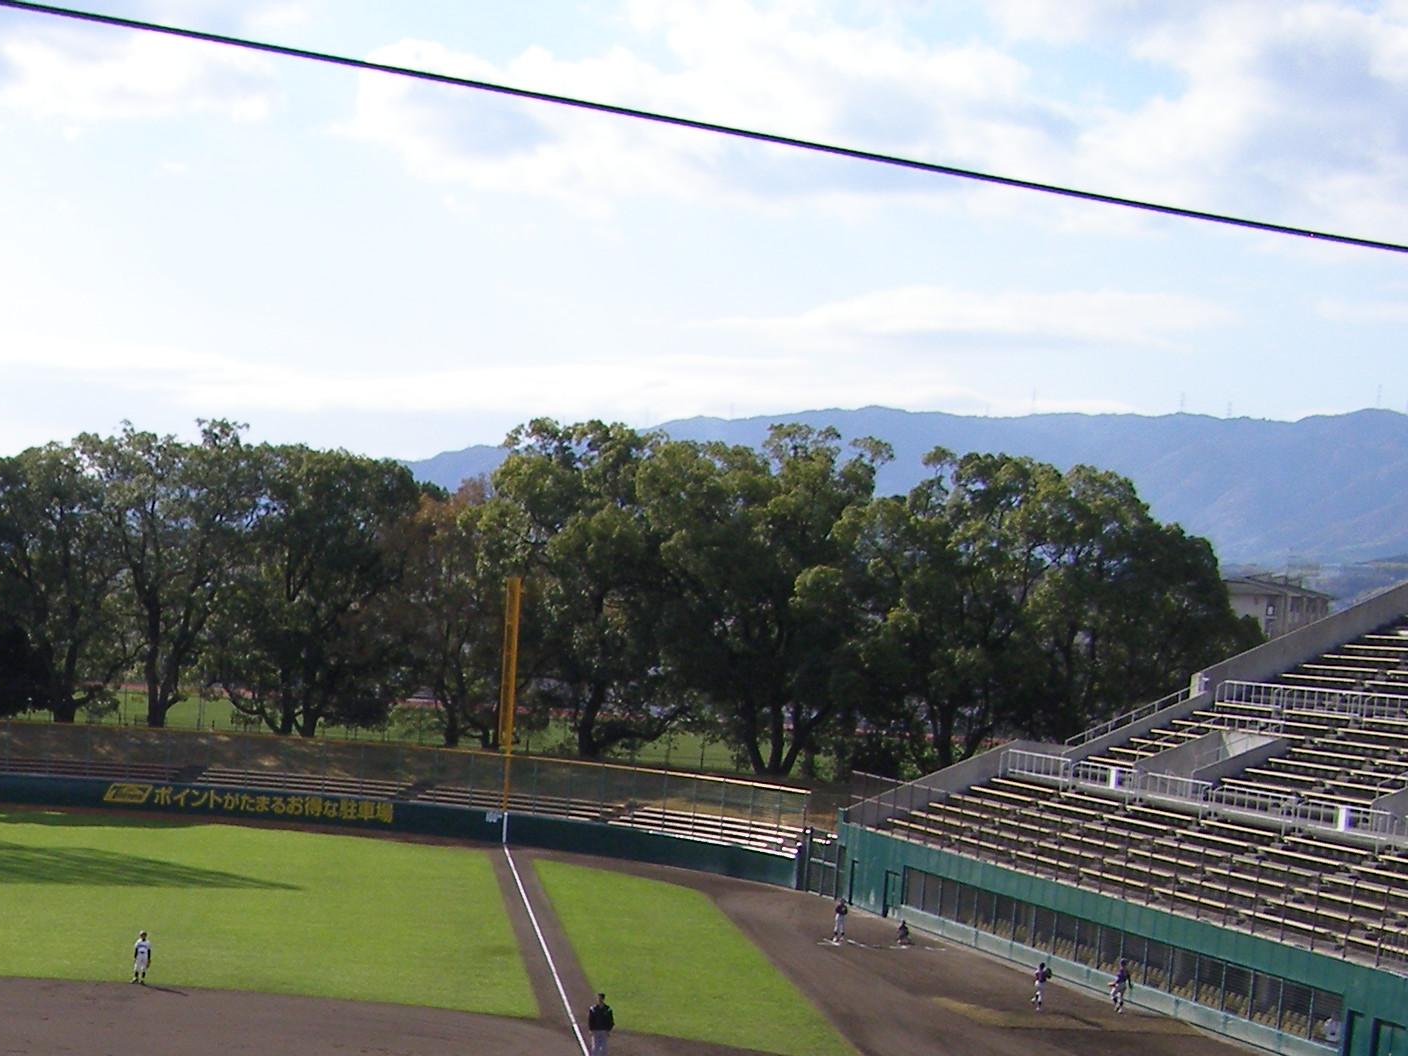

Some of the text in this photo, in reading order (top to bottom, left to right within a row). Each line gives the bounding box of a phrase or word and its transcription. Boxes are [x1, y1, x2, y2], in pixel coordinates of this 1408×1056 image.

[154, 785, 395, 824] ポイントがたまるお得な駐車場
